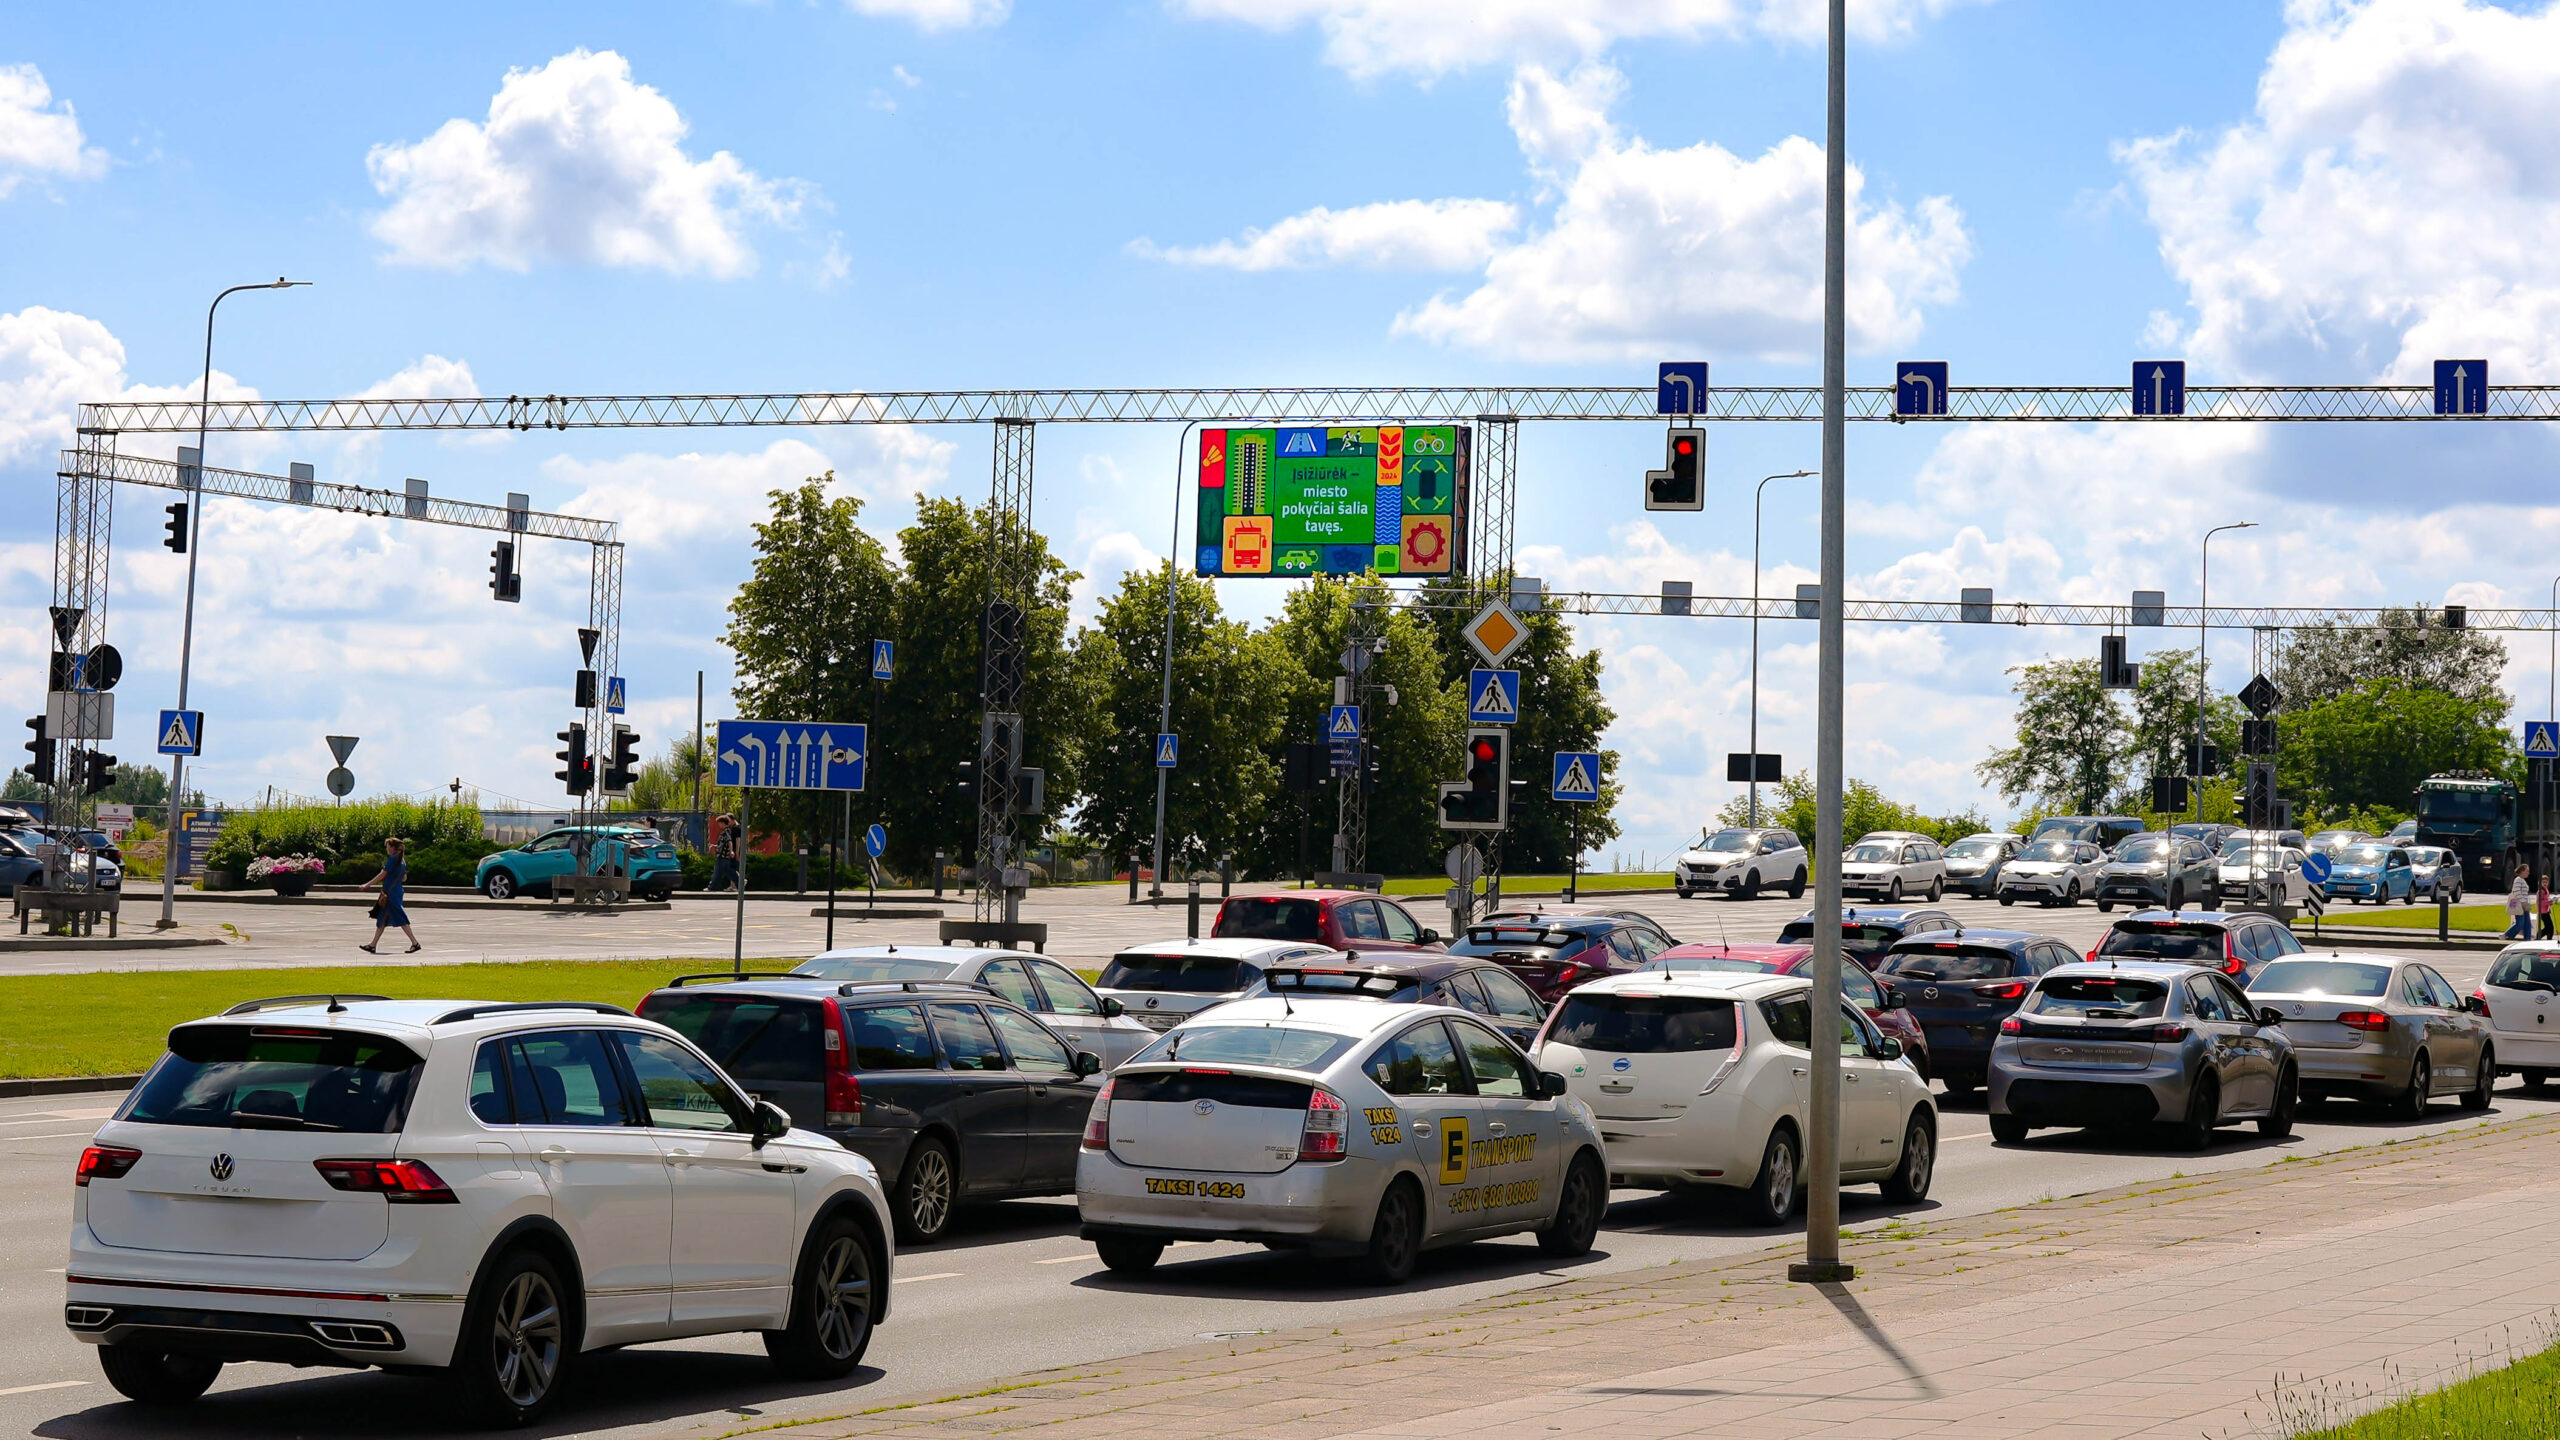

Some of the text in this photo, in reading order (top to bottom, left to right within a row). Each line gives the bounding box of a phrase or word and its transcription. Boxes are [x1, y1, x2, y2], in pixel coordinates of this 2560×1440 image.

[1292, 467, 1347, 484] Įsižiūrėk
[1380, 472, 1398, 480] 2024
[1303, 485, 1348, 498] miesto
[1282, 501, 1368, 518] pokyčiai šalia
[1305, 521, 1343, 535] tavęs.
[1363, 1107, 1398, 1125] TAKSI
[1371, 1127, 1401, 1145] 1424
[1447, 1131, 1536, 1171] E TRANSPORT
[1145, 1178, 1245, 1198] TAKSI 1424
[1448, 1187, 1480, 1214] +370
